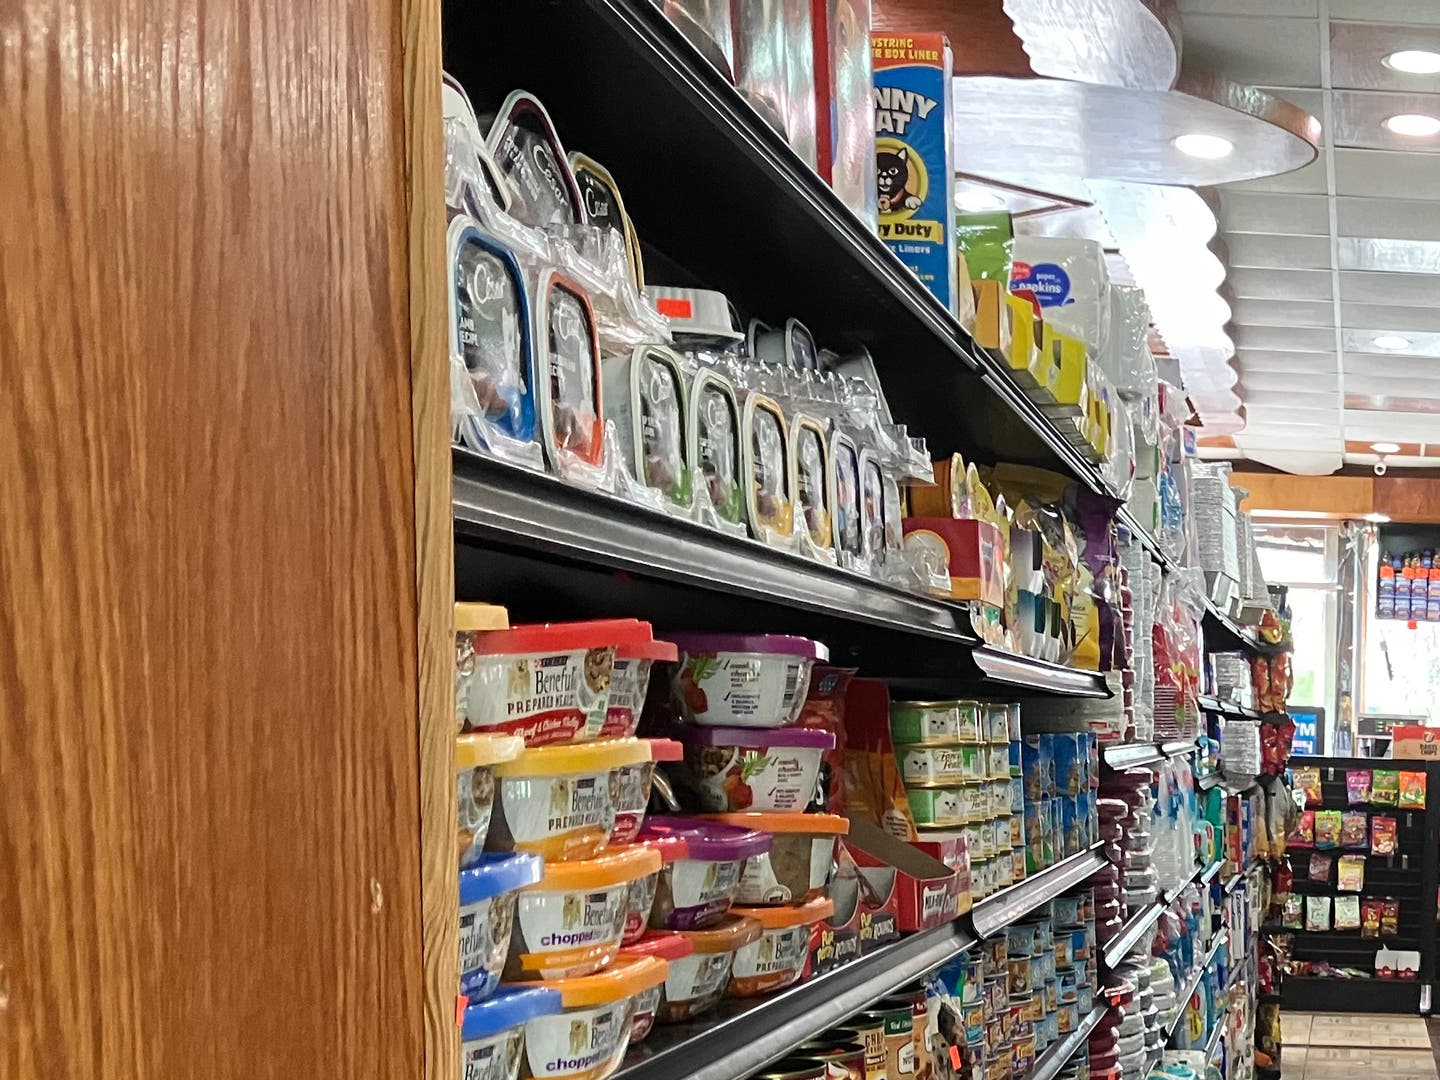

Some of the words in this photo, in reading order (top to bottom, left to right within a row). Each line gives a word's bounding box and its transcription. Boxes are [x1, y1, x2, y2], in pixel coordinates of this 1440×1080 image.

[884, 50, 905, 59] BOX
[907, 50, 939, 61] LINER
[874, 110, 911, 135] AT
[894, 222, 932, 239] Duty
[535, 666, 577, 694] Beneful
[507, 698, 554, 715] PREPARED
